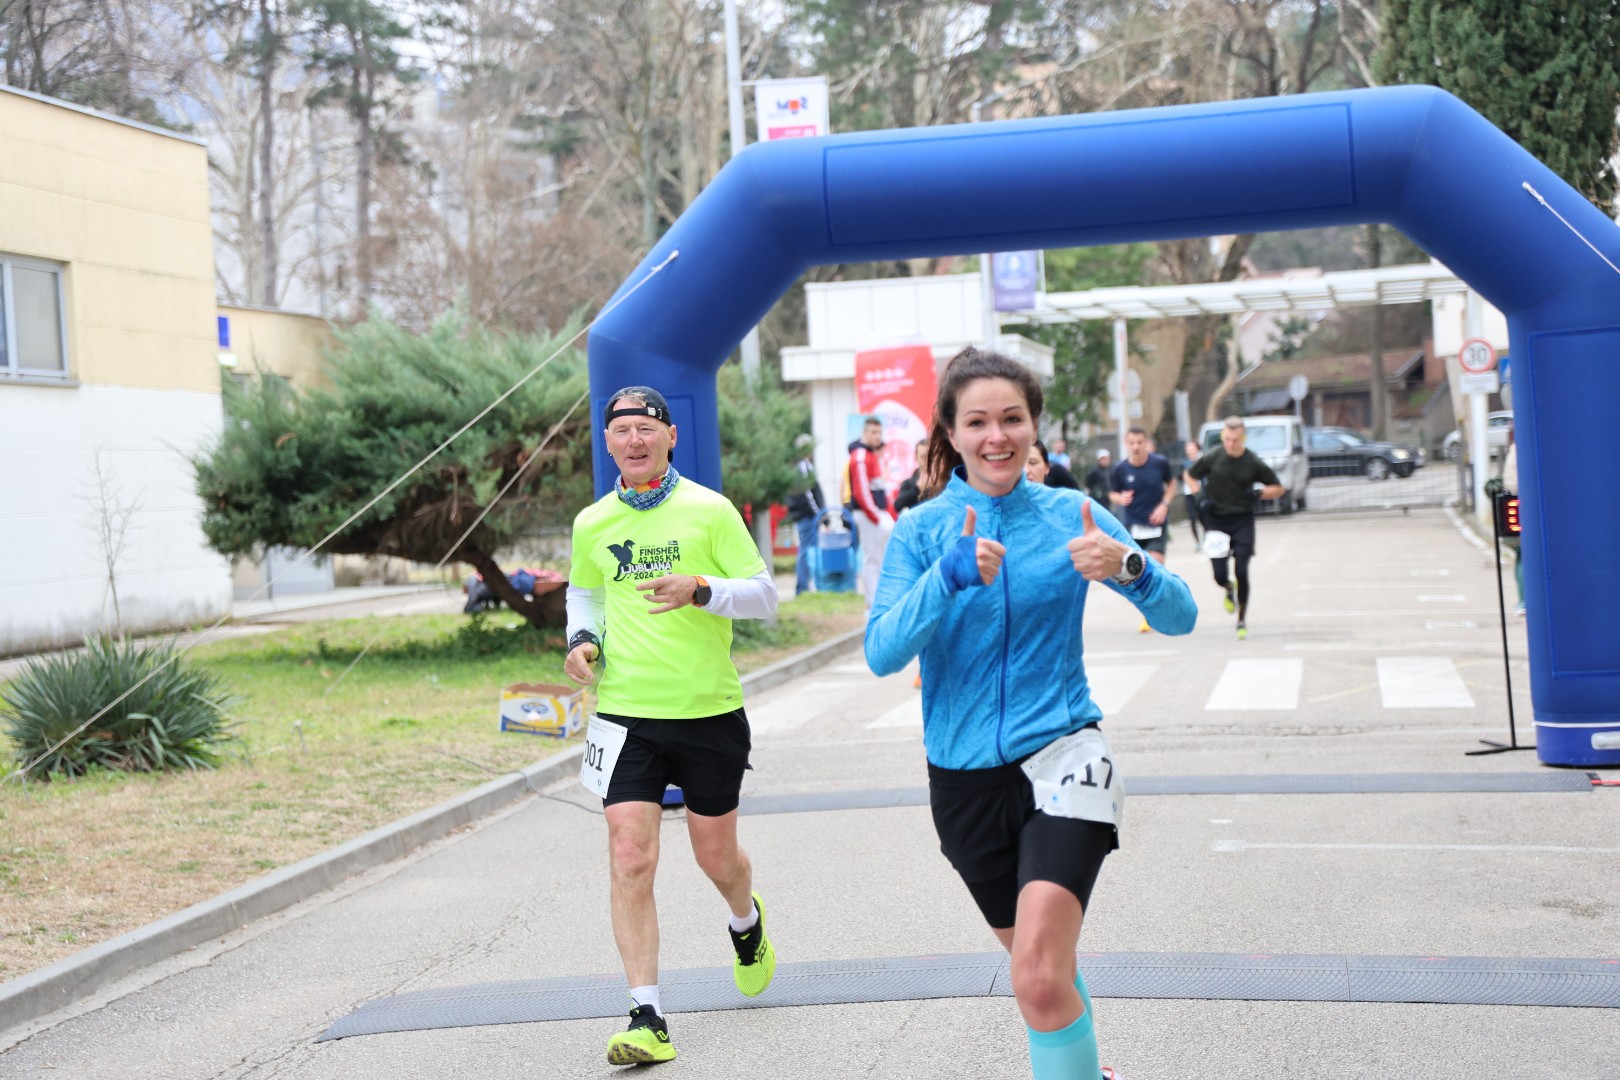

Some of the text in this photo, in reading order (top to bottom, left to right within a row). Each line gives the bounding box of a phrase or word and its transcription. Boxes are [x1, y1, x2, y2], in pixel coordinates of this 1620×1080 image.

[1467, 347, 1488, 366] 30
[639, 547, 679, 556] FINISHER
[666, 554, 680, 562] KM
[621, 562, 672, 573] LJUBLJANA
